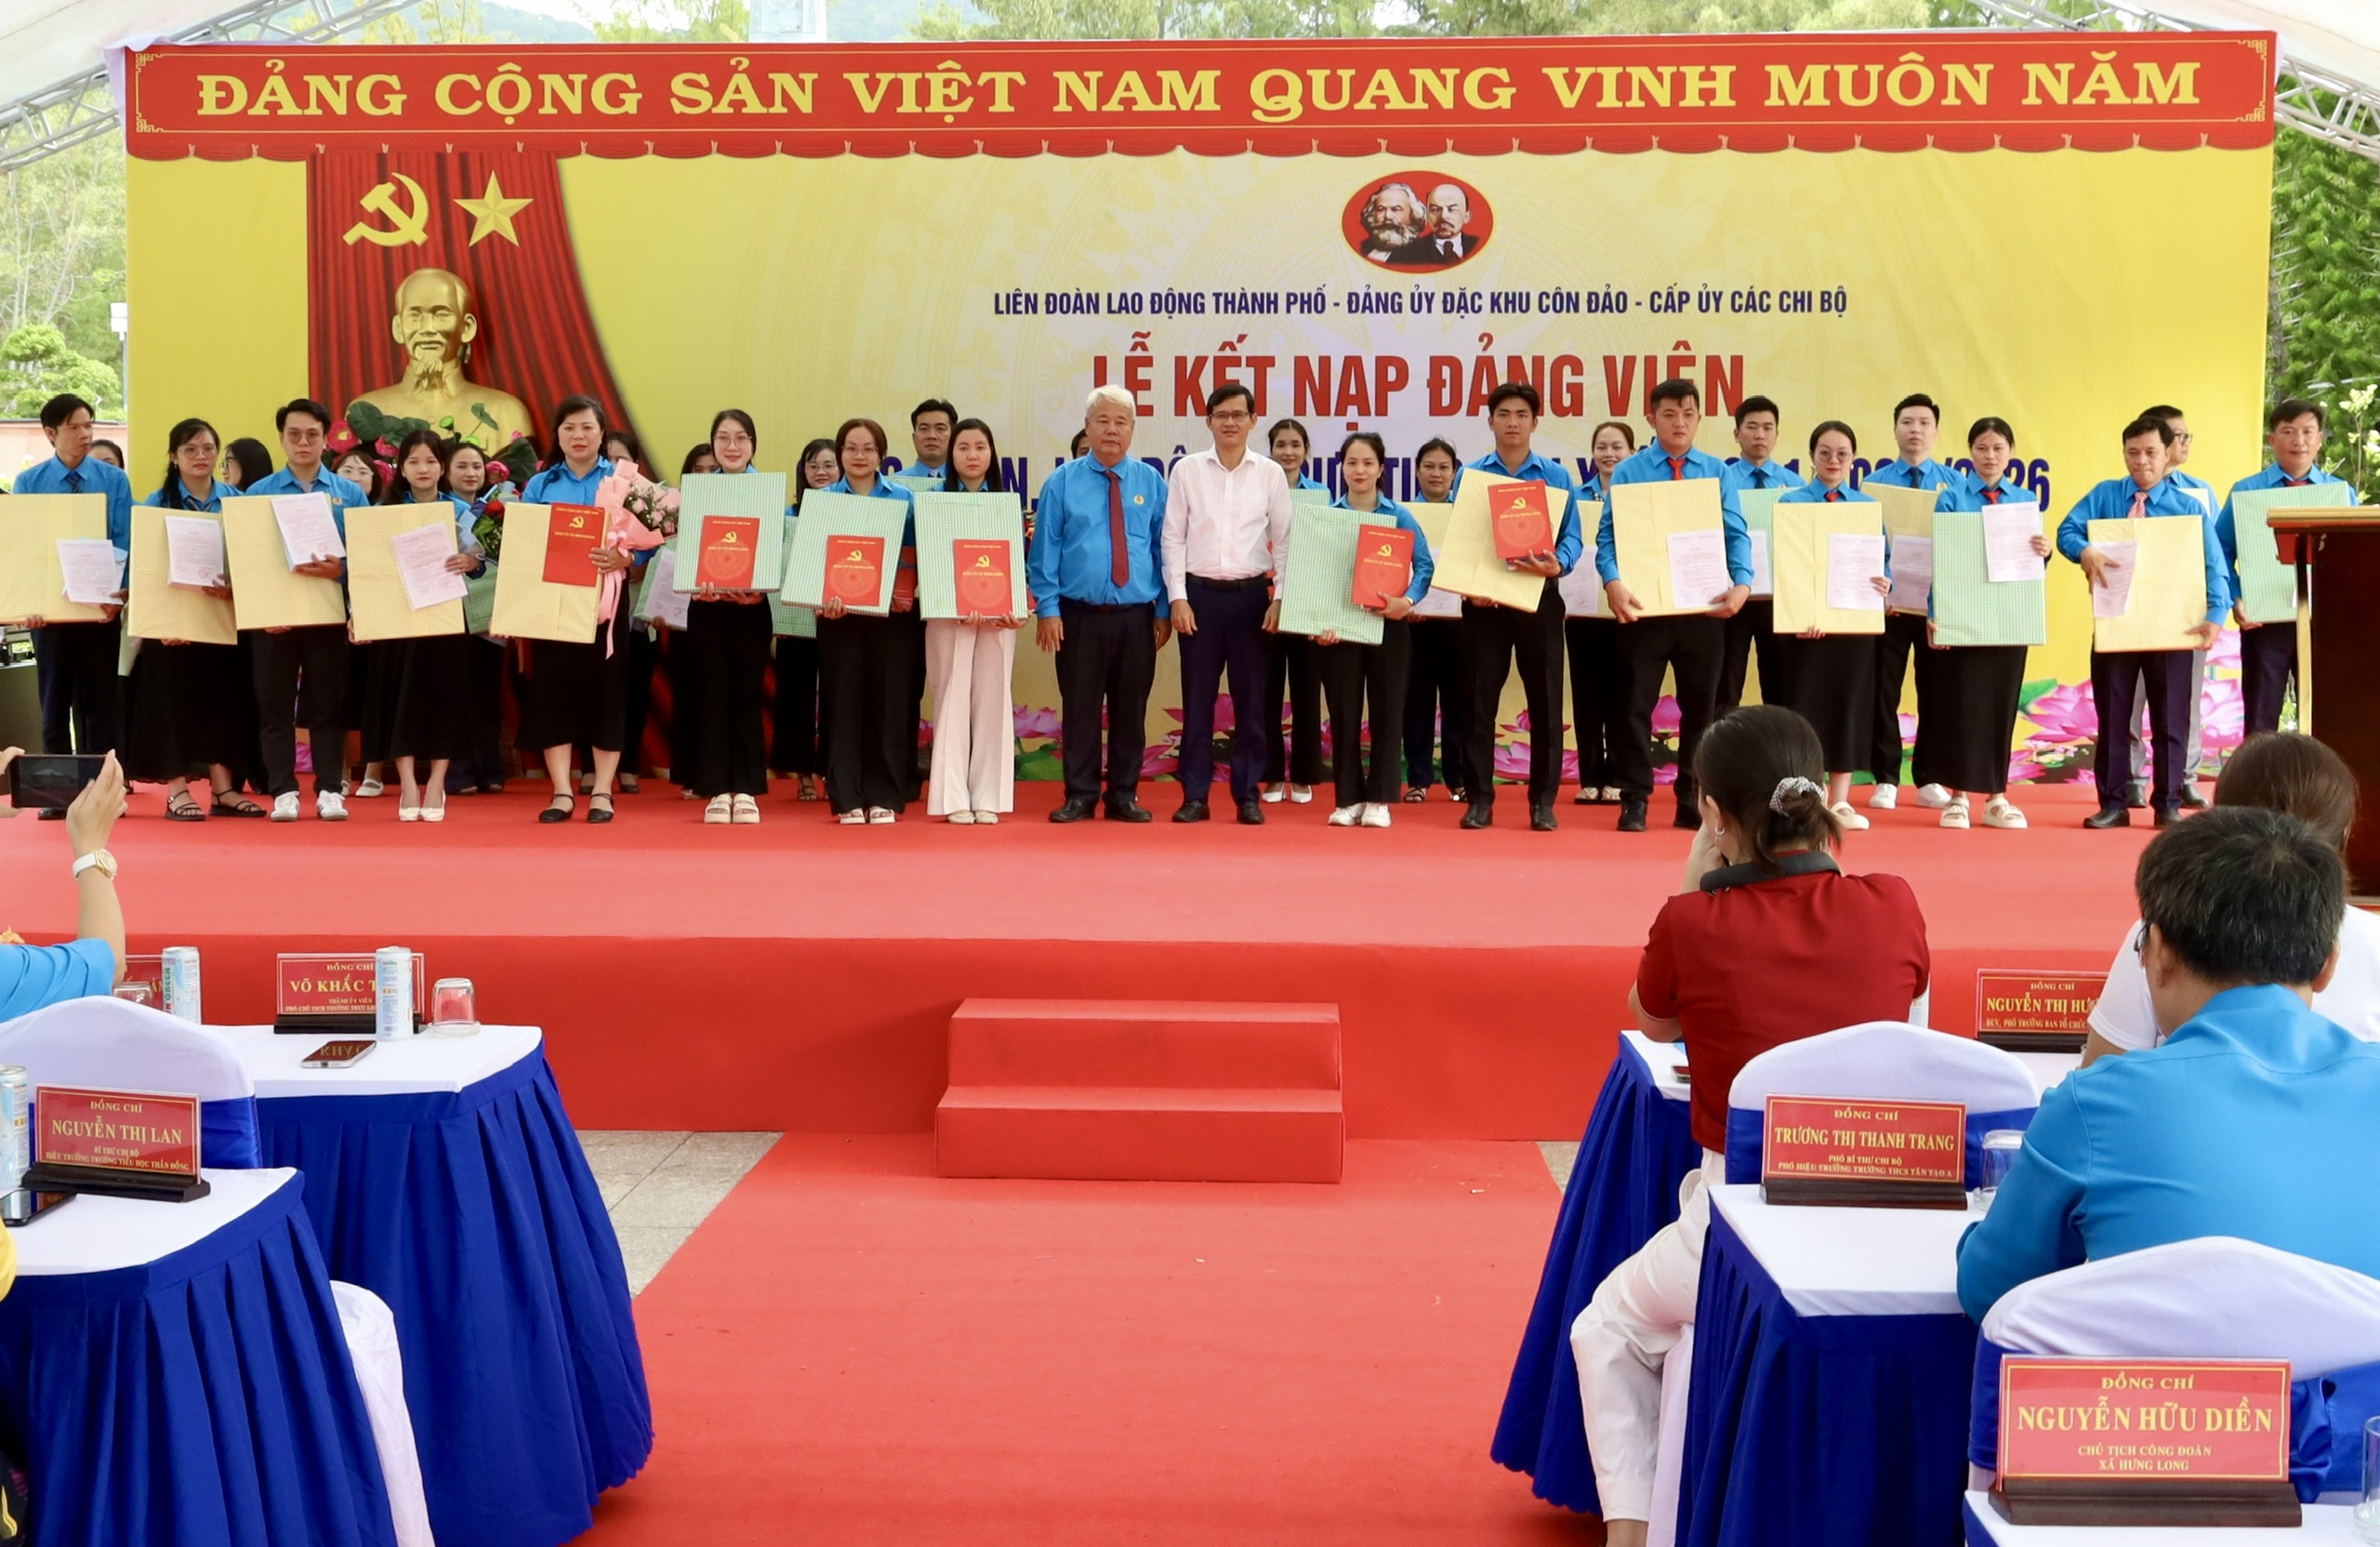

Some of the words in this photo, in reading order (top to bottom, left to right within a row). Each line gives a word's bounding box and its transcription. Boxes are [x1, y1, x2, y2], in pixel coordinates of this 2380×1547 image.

[196, 59, 407, 116] ĐẢNG
[434, 61, 642, 126] CỘNG
[669, 58, 819, 114] SẢN
[842, 60, 1026, 123] VIỆT
[1052, 70, 1222, 112] NAM
[1250, 67, 1517, 123] QUANG
[1541, 65, 1737, 109] VINH
[1764, 52, 1994, 107] MUÔN
[2021, 51, 2202, 105] NĂM
[994, 287, 1038, 315] LIÊN
[1044, 287, 1100, 315] ĐOÀN
[1106, 292, 1144, 315] LAO
[1149, 287, 1206, 320] ĐỘNG
[1211, 286, 1279, 314] THÀNH
[1286, 284, 1327, 314] PHỐ
[1346, 284, 1403, 314] ĐẢNG
[1409, 284, 1435, 314] ỦY
[1441, 286, 1483, 319] ĐẶC
[1489, 291, 1531, 314] KHU
[1538, 286, 1580, 314] CÔN
[1586, 283, 1628, 314] ĐẢO
[1649, 283, 1691, 314] CẤP
[1698, 283, 1724, 313] ỦY
[1730, 285, 1771, 313] CÁC
[1778, 290, 1813, 313] CHI
[1819, 285, 1847, 318] BỘ
[1174, 334, 1276, 416] KẾT
[1294, 355, 1409, 431] NẠP
[1426, 332, 1584, 417] ĐẢNG
[326, 962, 354, 972] ĐỒNG
[289, 978, 312, 993] VÕ
[317, 973, 364, 992] KHẮC
[2030, 981, 2056, 990] ĐỒNG
[2058, 982, 2075, 991] CHÍ
[1986, 992, 2042, 1012] NGUYỄN
[2044, 998, 2068, 1015] THỊ
[90, 1098, 121, 1112] ĐỒNG
[123, 1103, 142, 1114] CHÍ
[1833, 1106, 1871, 1120] ĐỒNG
[1874, 1110, 1899, 1121] CHÍ
[51, 1116, 115, 1140] NGUYỄN
[119, 1124, 146, 1144] THỊ
[151, 1127, 182, 1144] LAN
[1774, 1125, 1829, 1145] TRƯƠNG
[1832, 1130, 1856, 1149] THỊ
[1859, 1130, 1906, 1149] THANH
[1909, 1133, 1955, 1151] TRANG
[1778, 1160, 1794, 1170] PHÓ
[1796, 1162, 1817, 1171] HIỆU
[1888, 1167, 1909, 1176] THCS
[1911, 1166, 1927, 1177] TÂN
[1828, 1153, 1844, 1163] PHÓ
[1846, 1154, 1856, 1163] BÍ
[1857, 1155, 1874, 1164] THƯ
[1874, 1157, 1889, 1165] CHI
[1890, 1156, 1902, 1167] BỘ
[2101, 1370, 2154, 1390] ĐỒNG
[2160, 1374, 2195, 1390] CHÍ
[2017, 1395, 2132, 1431] NGUYỄN
[2138, 1401, 2198, 1432] HỮU
[2203, 1395, 2273, 1433] DIỀN
[2077, 1442, 2104, 1456] CHỦ
[2106, 1445, 2137, 1458] TỊCH
[2139, 1443, 2175, 1457] CÔNG
[2177, 1443, 2212, 1457] ĐOÀN
[2098, 1457, 2115, 1471] XÃ
[2119, 1458, 2154, 1471] HƯNG
[2156, 1460, 2189, 1471] LONG
